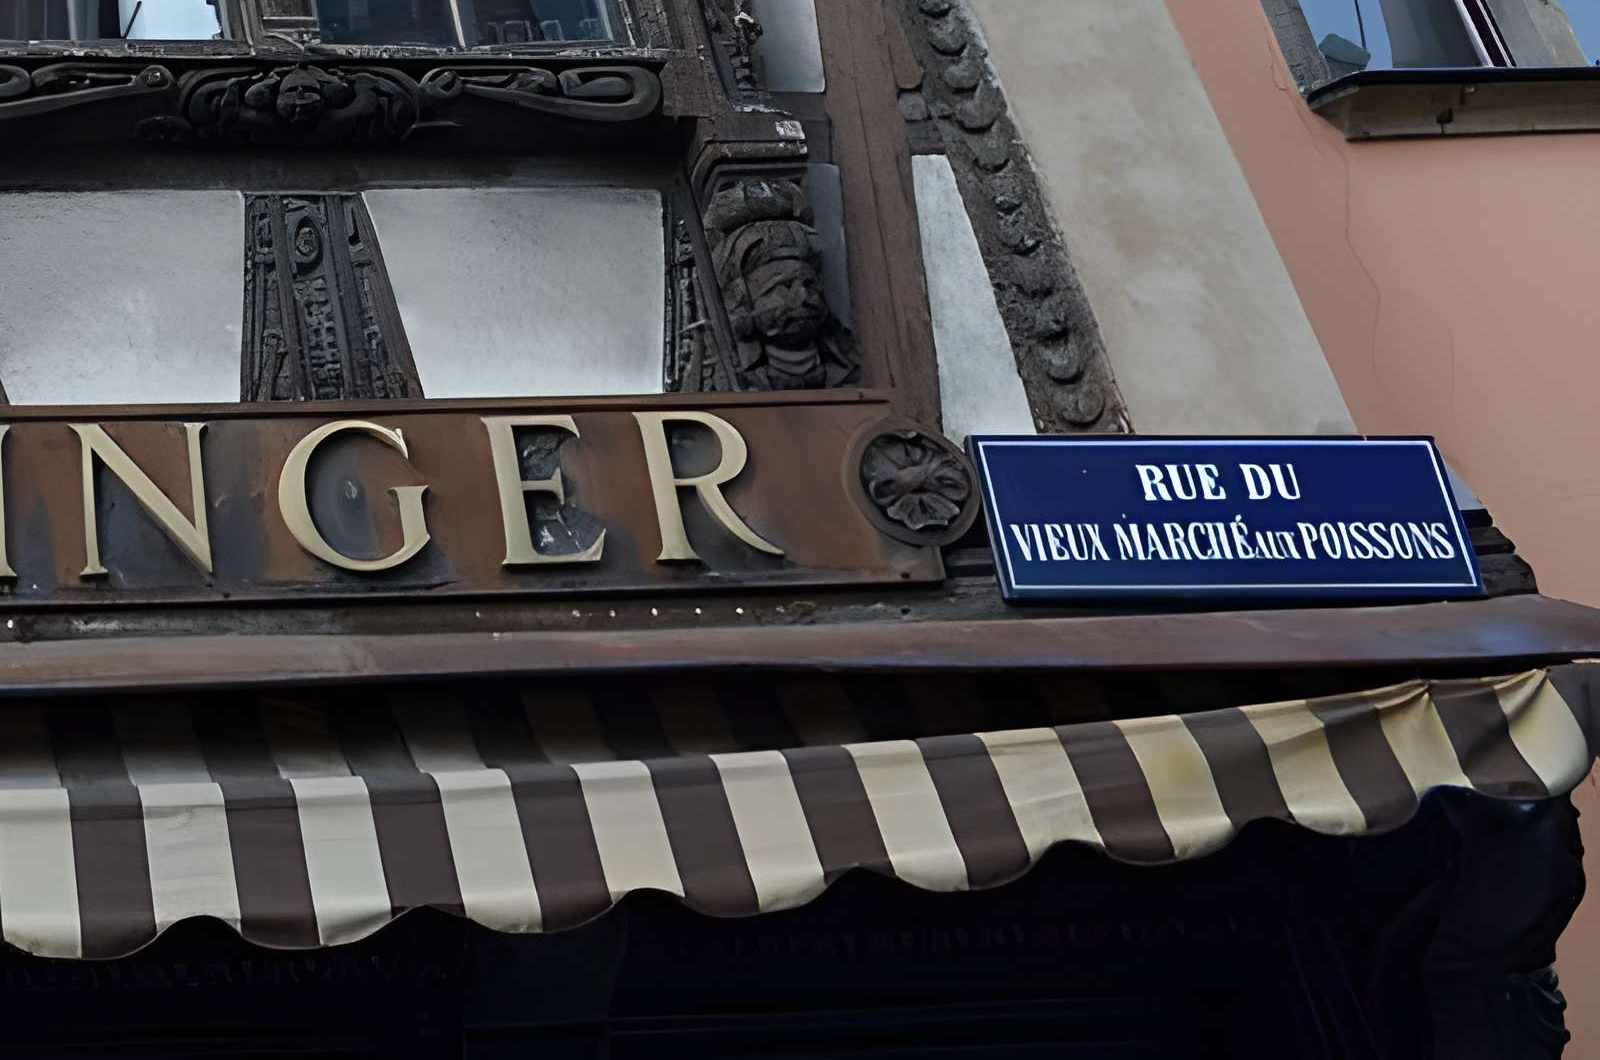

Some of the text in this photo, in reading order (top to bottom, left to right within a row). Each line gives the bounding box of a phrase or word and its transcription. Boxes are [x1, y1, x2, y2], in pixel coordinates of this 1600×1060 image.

[1135, 463, 1301, 501] RUE DU
[1009, 523, 1111, 562] VIEUX
[1112, 513, 1257, 560] MARCHÉ
[1296, 521, 1456, 560] POISSONS
